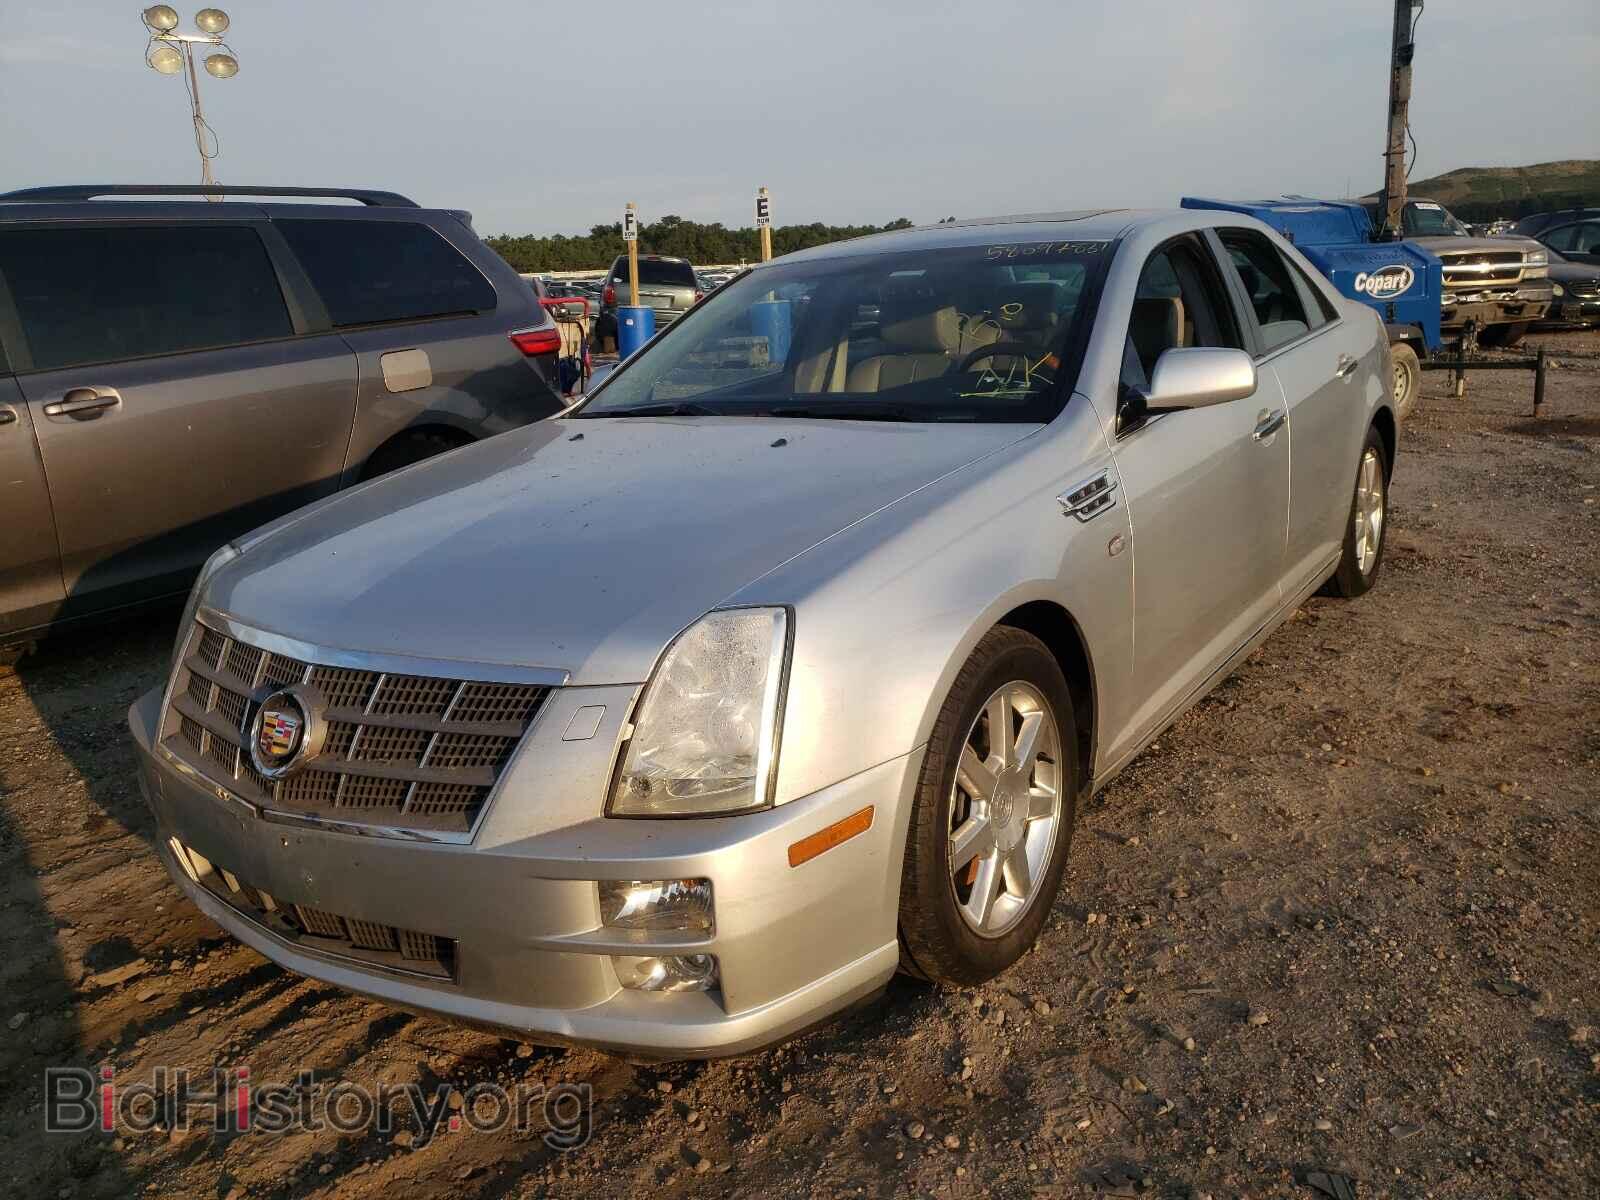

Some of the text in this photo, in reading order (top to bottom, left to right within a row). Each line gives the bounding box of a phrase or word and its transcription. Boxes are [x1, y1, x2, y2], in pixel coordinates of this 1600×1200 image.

[757, 198, 769, 217] E
[625, 213, 634, 231] F
[1354, 270, 1408, 295] Copart
